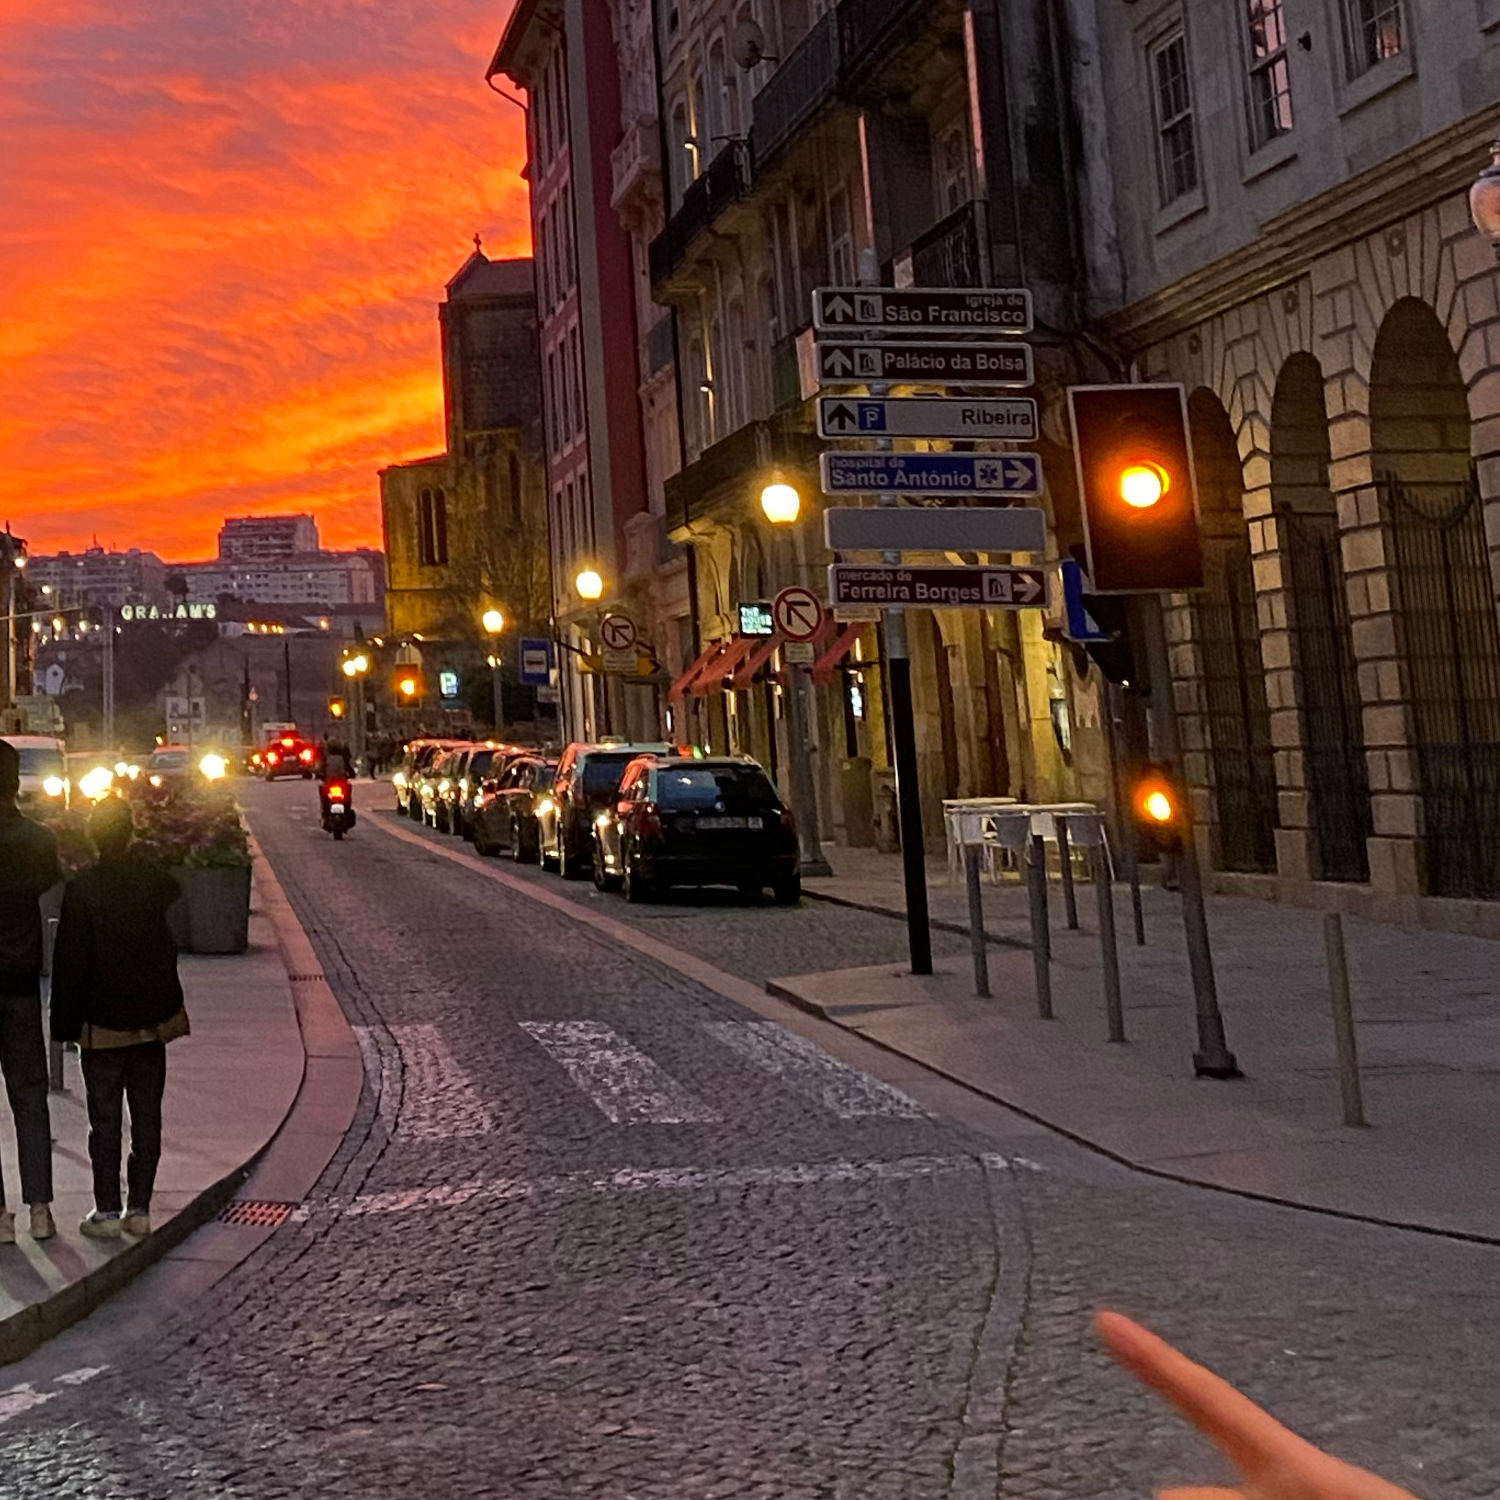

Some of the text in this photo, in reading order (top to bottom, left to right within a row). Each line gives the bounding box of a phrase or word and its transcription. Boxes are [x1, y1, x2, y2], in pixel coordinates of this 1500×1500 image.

[885, 304, 1025, 323] São Francisco
[884, 352, 1025, 370] Palácio da Bolsa
[866, 408, 1031, 428] P Ribeira
[830, 456, 905, 469] hospital de
[832, 468, 972, 487] Santo António
[838, 569, 894, 582] mercado
[839, 582, 981, 604] Ferreira Borges
[120, 604, 216, 621] GRAAM'S
